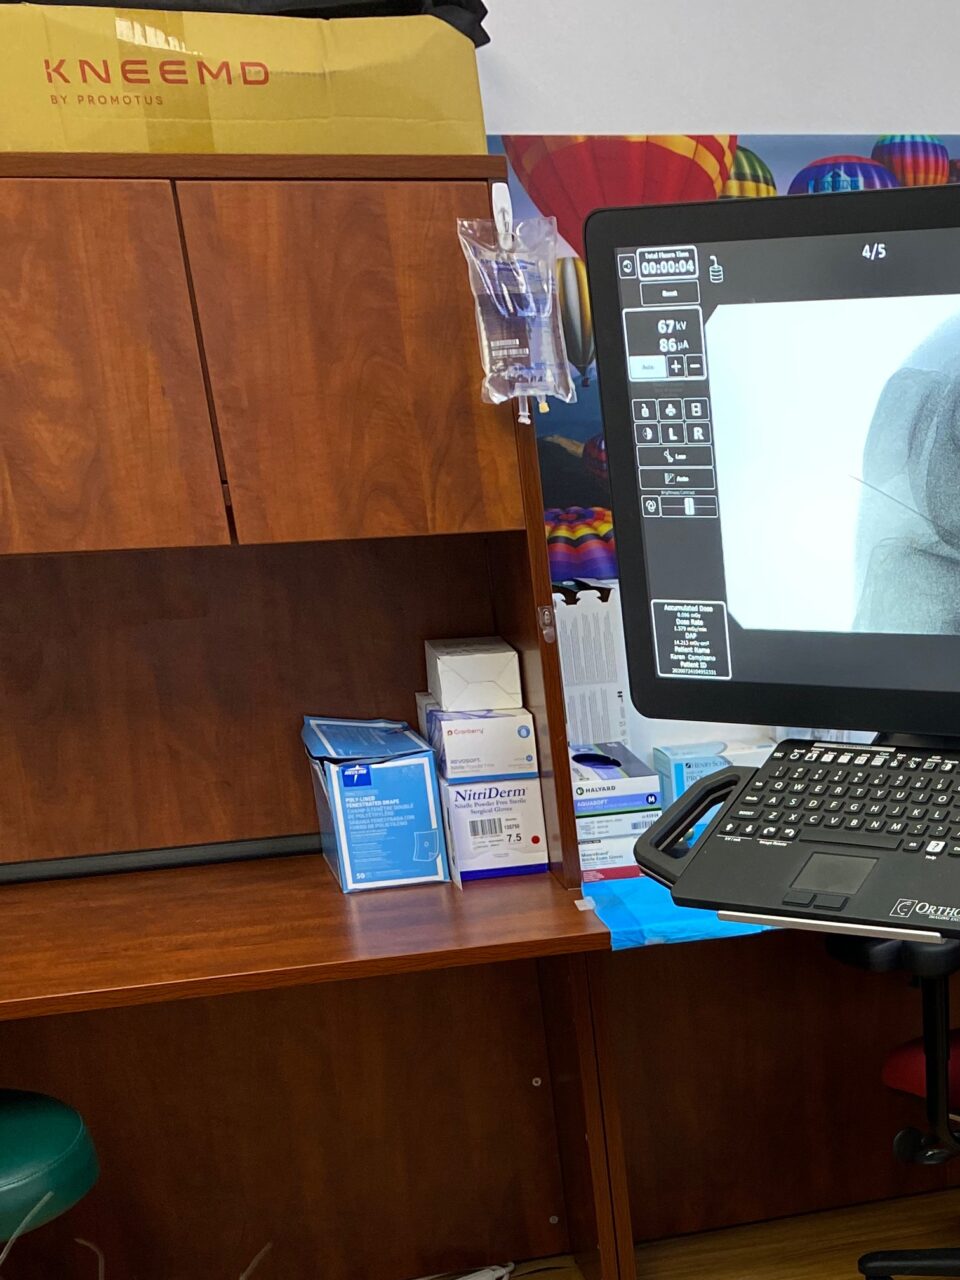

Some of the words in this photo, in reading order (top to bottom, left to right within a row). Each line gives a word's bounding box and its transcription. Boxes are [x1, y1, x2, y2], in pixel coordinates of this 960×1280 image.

[44, 58, 270, 86] KNEEMD
[50, 94, 68, 105] BY
[77, 95, 164, 106] PROMOTUS
[862, 243, 887, 260] 4/5
[641, 259, 695, 275] 00:00:04
[658, 320, 674, 334] 67
[675, 321, 687, 331] kV
[659, 338, 677, 353] 86
[668, 427, 678, 440] L
[693, 426, 704, 440] R
[664, 604, 698, 612] Accumulated
[675, 618, 690, 626] Dose
[690, 618, 704, 626] Rate
[694, 646, 710, 654] Name
[455, 786, 526, 802] NitriDerm
[585, 785, 616, 793] HALYARD
[506, 833, 522, 843] 7.5
